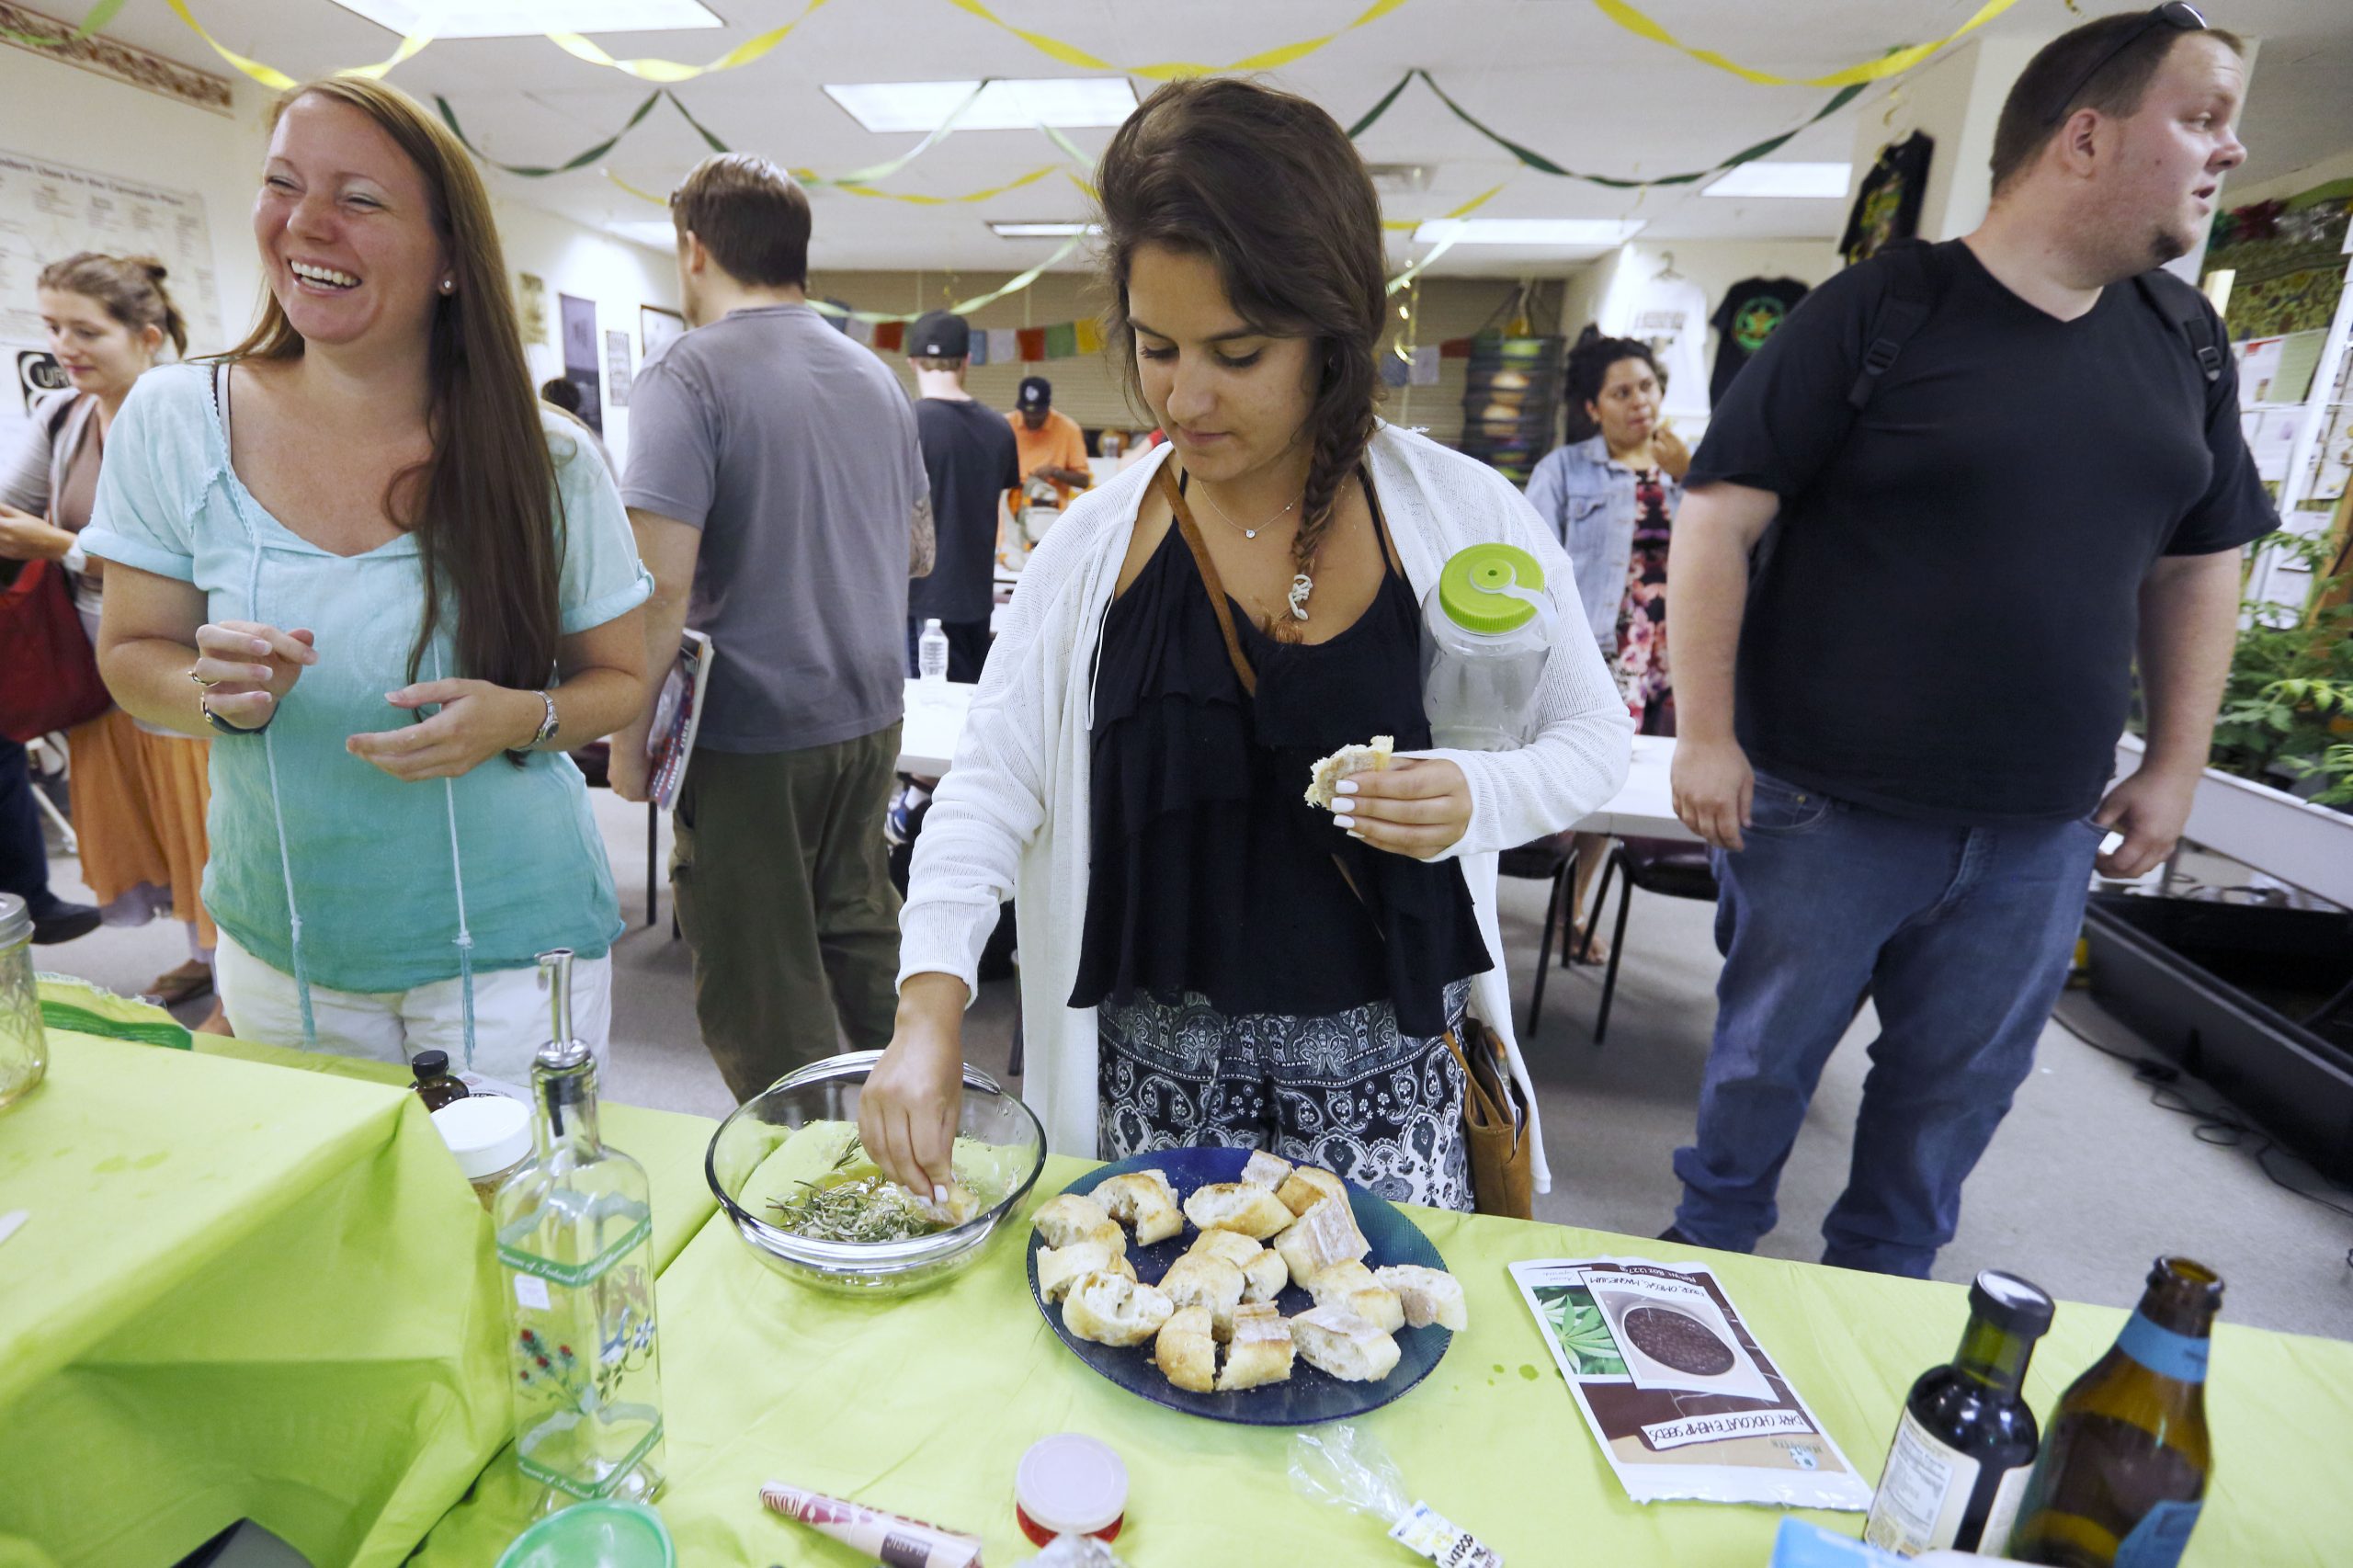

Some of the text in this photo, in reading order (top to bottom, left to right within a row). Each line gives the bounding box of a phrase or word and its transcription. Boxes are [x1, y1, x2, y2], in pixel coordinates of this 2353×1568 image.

[1686, 1419, 1715, 1436] HEMP
[1719, 1415, 1775, 1432] CHOCOLATE
[1649, 1426, 1684, 1441] SEEDS
